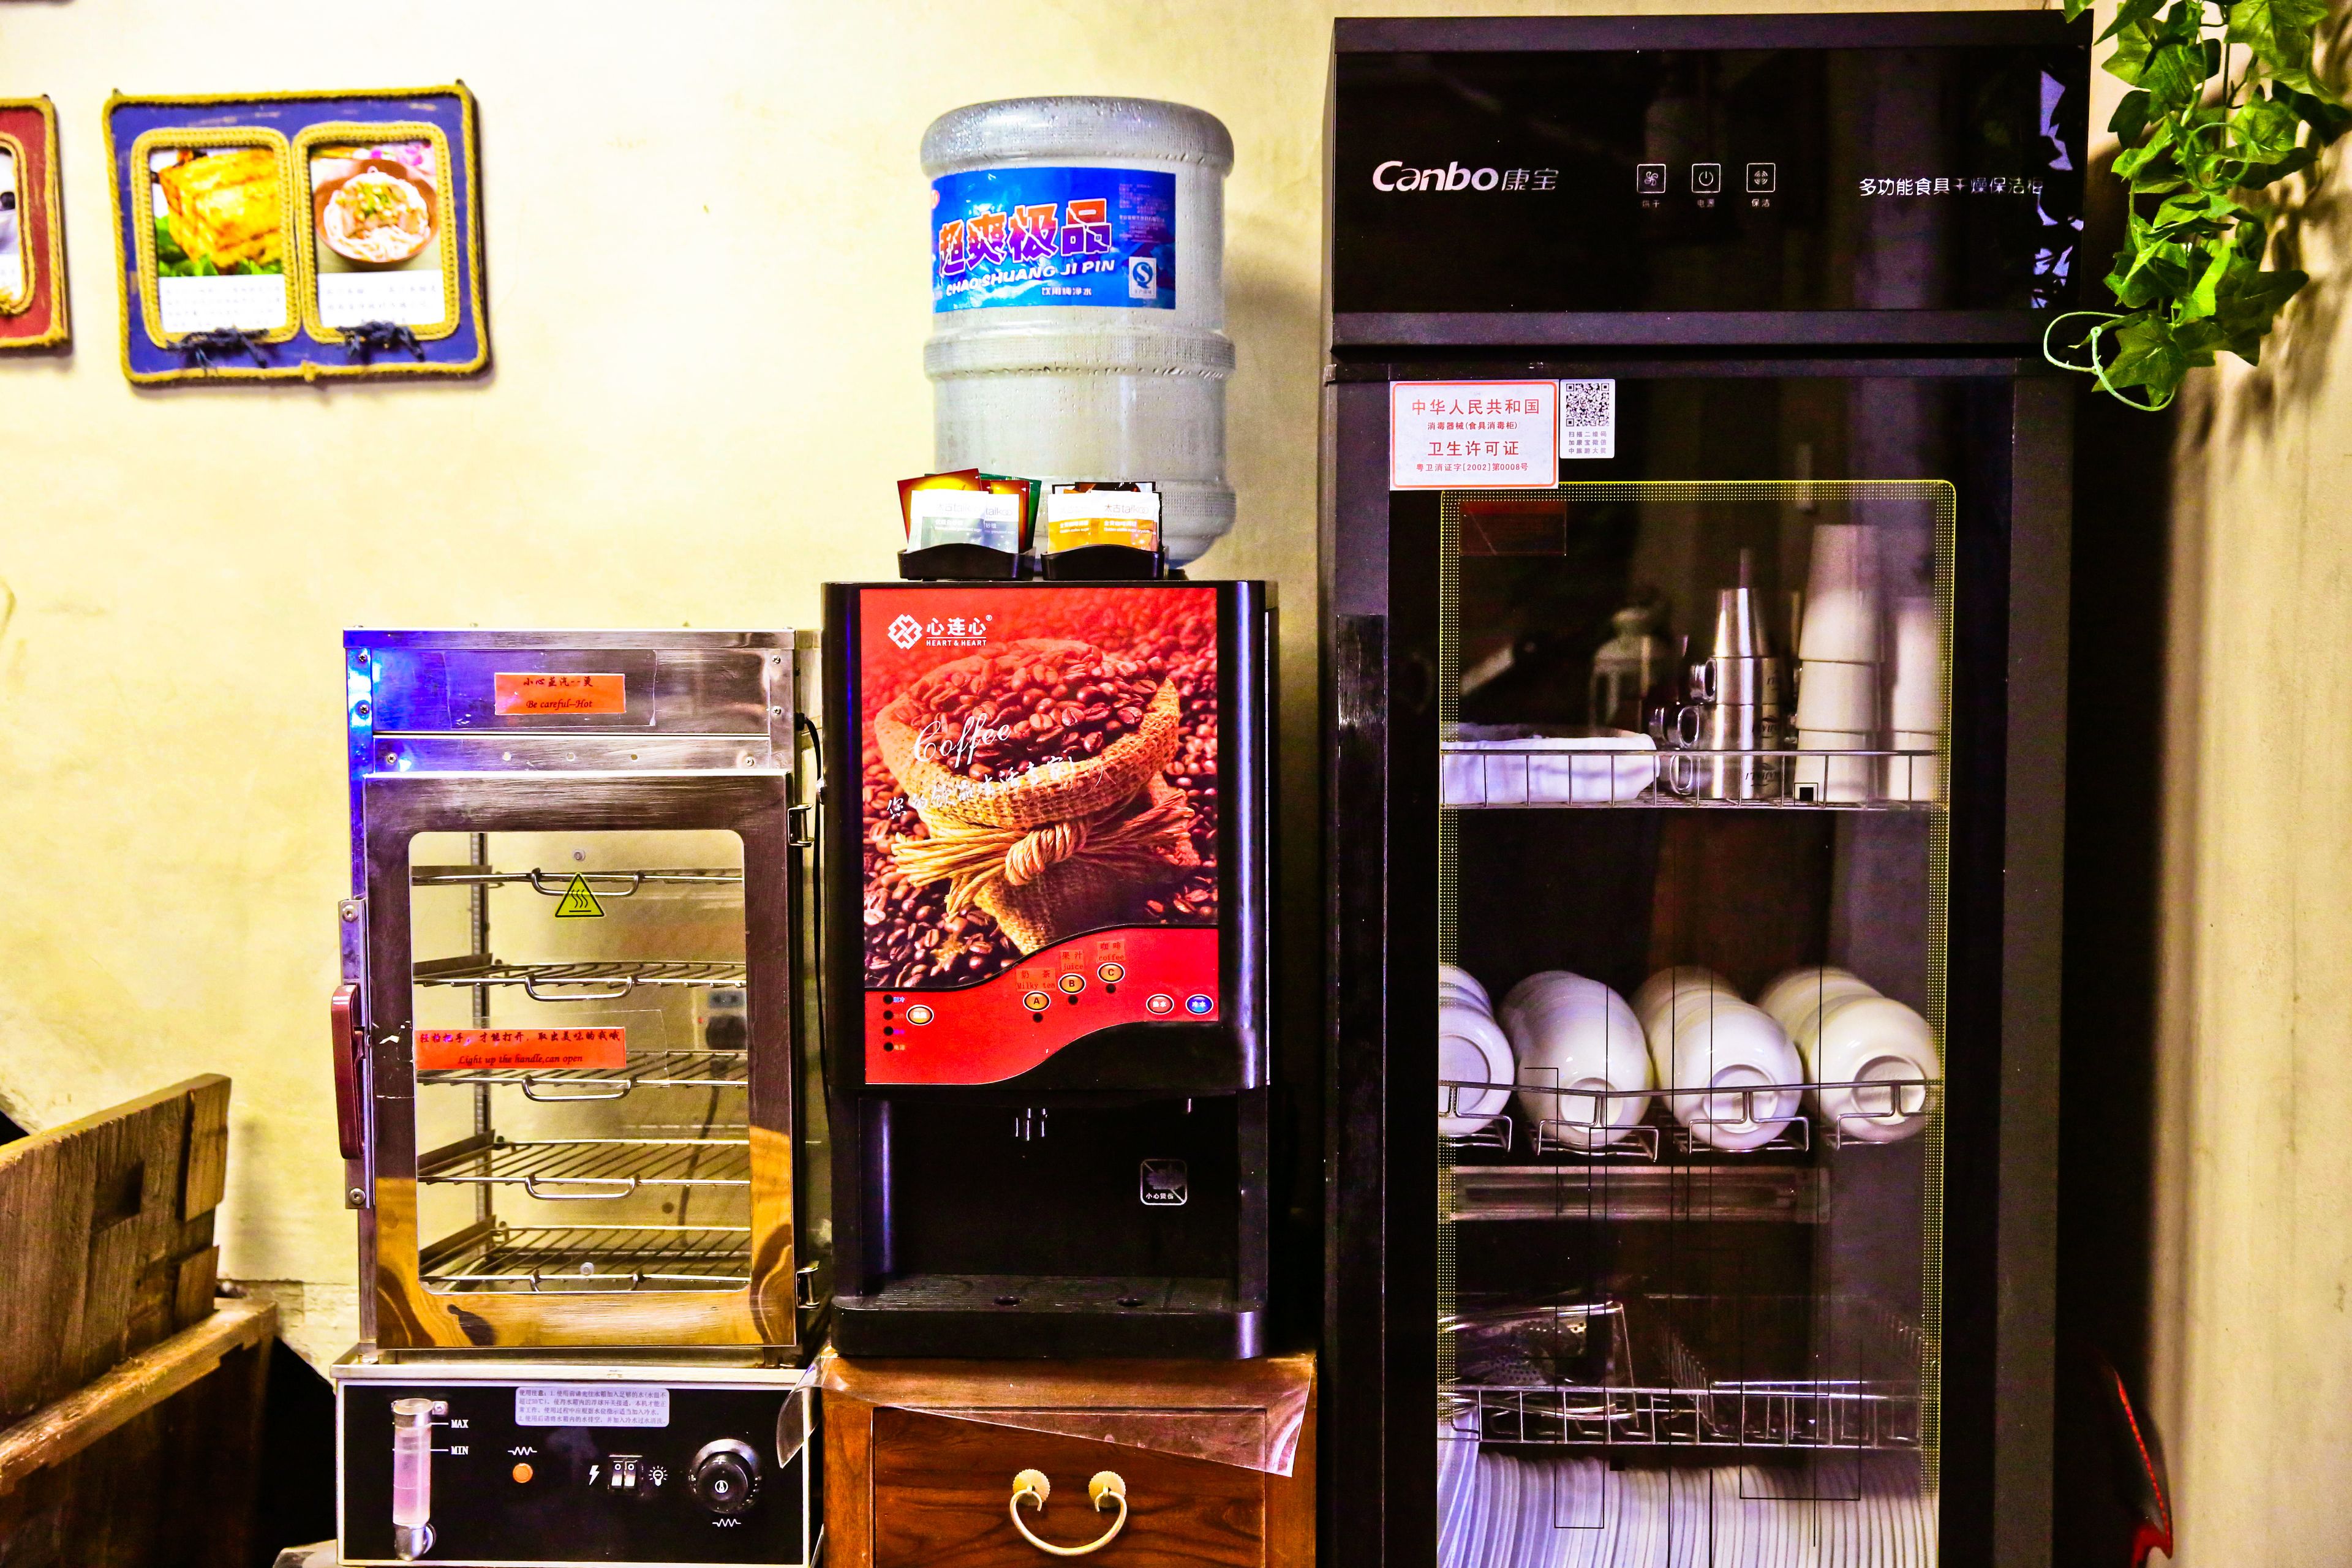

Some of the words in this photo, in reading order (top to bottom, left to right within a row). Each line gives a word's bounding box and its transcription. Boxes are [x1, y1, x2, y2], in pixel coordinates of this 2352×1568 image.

[1373, 160, 1499, 192] Canbo
[1501, 168, 1559, 191] 康宝
[938, 198, 1112, 279] 超爽极品
[946, 279, 979, 296] CHAO
[982, 265, 1056, 288] SHUANG
[1058, 263, 1079, 277] JI
[1082, 259, 1115, 274] PIN
[1411, 398, 1540, 416] 中华人民共和国
[1427, 421, 1518, 431] 消毒器械(食具消毒柜)
[1427, 440, 1520, 456] 卫生许可证
[927, 617, 987, 636] 心连心
[911, 712, 1012, 768] Coffee
[1100, 942, 1121, 951] 咖啡
[1061, 951, 1083, 960] 果汁
[458, 1055, 482, 1065] Light
[484, 1057, 496, 1066] up
[499, 1054, 512, 1063] the
[562, 1055, 583, 1065] open
[451, 1419, 469, 1428] MAX
[451, 1446, 469, 1455] MIN
